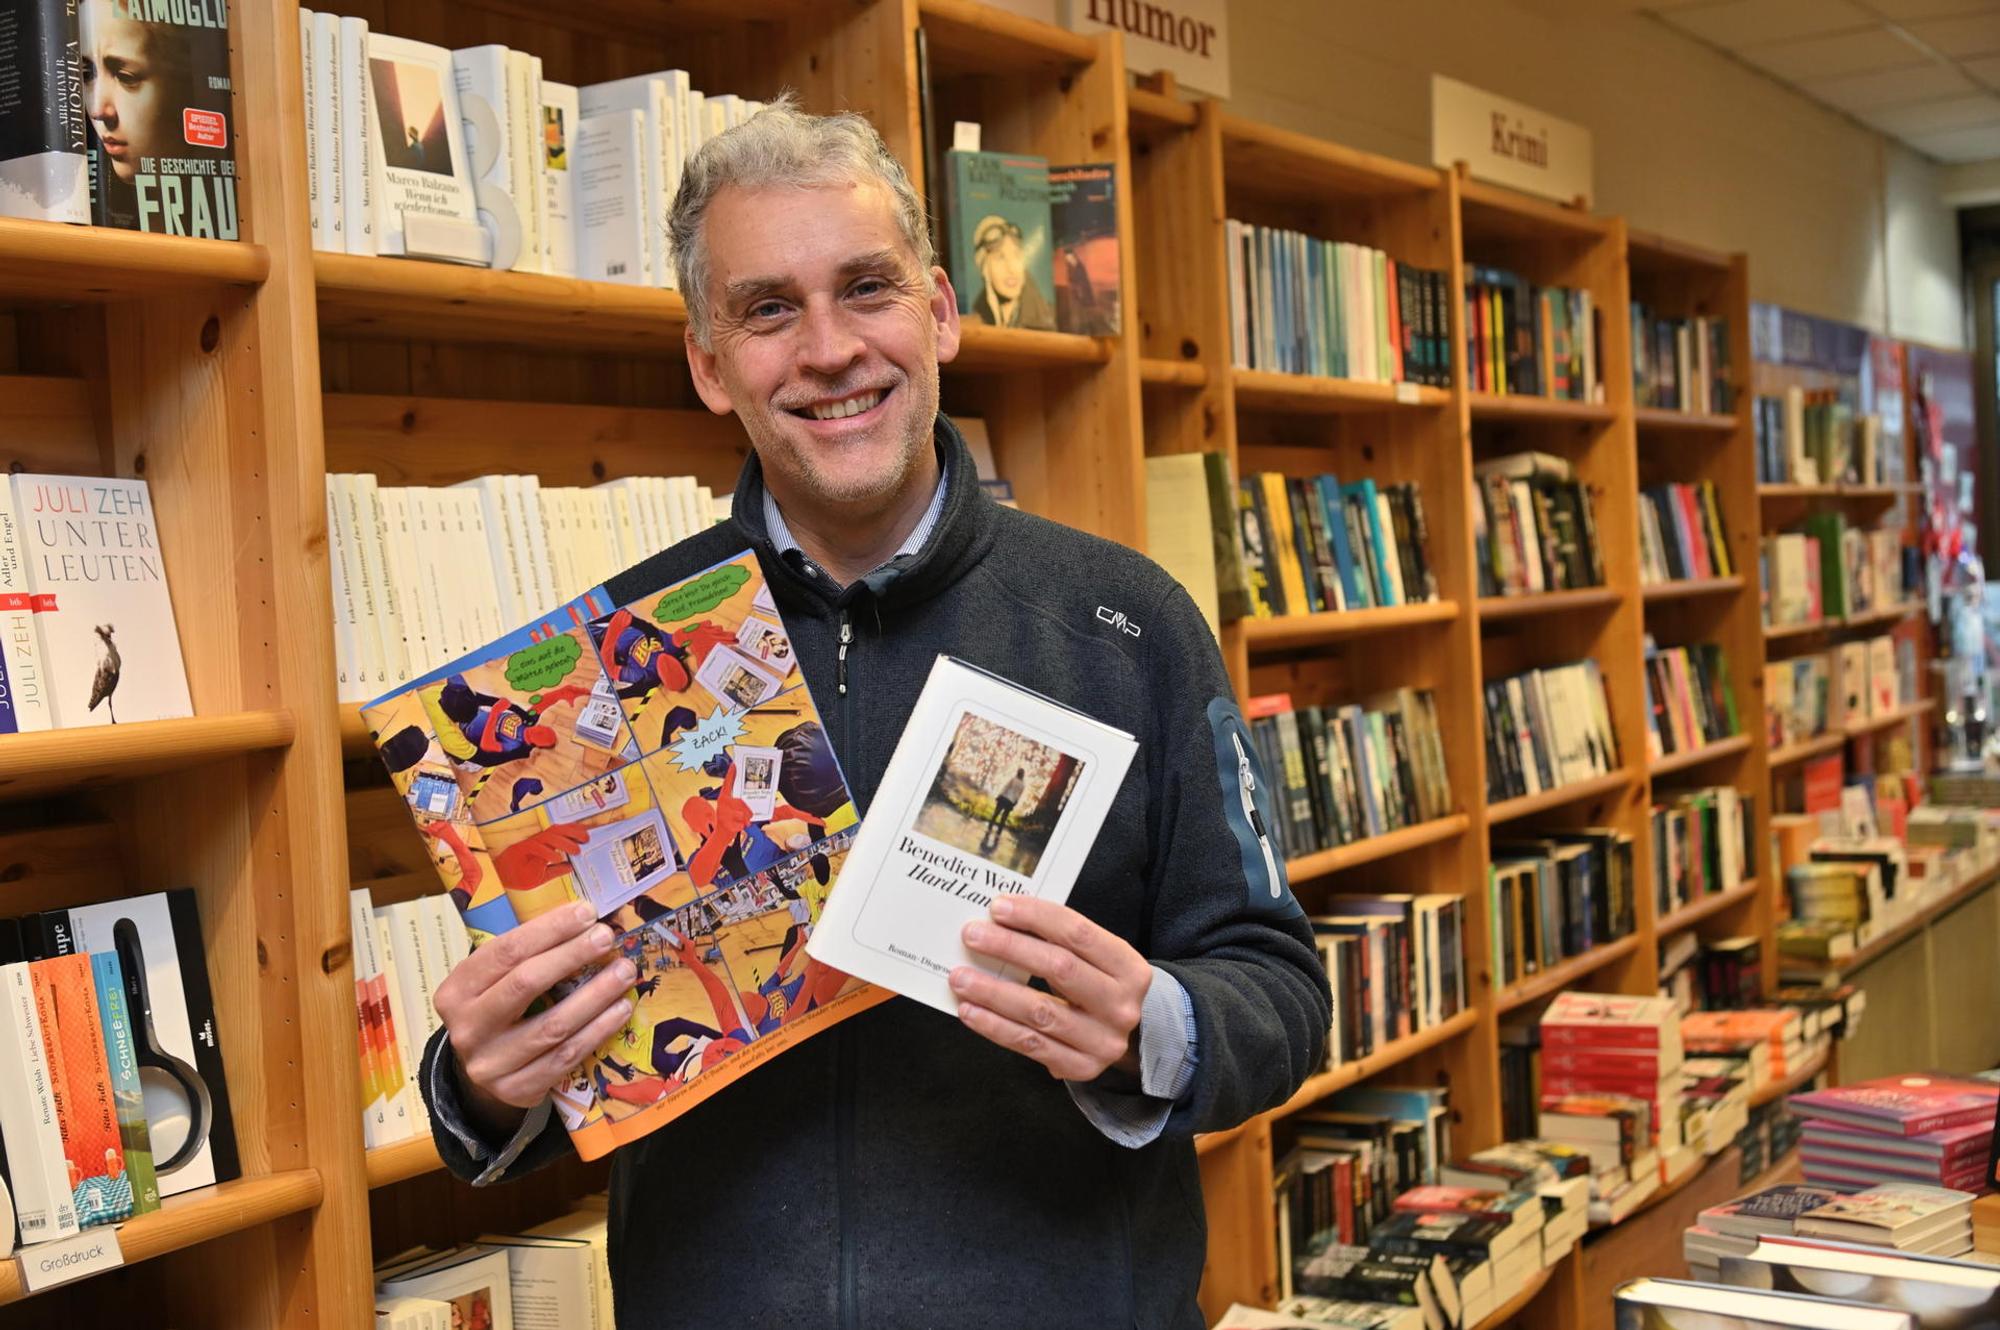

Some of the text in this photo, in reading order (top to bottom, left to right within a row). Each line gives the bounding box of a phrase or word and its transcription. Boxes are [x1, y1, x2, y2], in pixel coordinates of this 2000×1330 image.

[57, 67, 69, 127] ABRAHAM
[66, 41, 85, 149] YEHOSHUA
[1490, 111, 1549, 169] Krimi
[141, 157, 156, 174] DIE
[161, 158, 217, 176] GESCHICHTE
[386, 172, 460, 193] Marco Balzano
[405, 188, 432, 202] Wenn
[134, 175, 239, 241] FRAU
[33, 484, 146, 515] JULI ZEH
[1, 513, 14, 544] Engel
[37, 519, 154, 549] UNTER
[3, 555, 13, 587] Adler
[43, 554, 160, 582] LEUTEN
[11, 616, 41, 708] JULI ZEH
[691, 726, 728, 749] ZACK!
[899, 836, 978, 881] Benedict
[907, 863, 992, 908] Hard Lan
[54, 923, 71, 956] upe
[887, 943, 917, 961] Roman
[39, 1092, 51, 1126] Renate
[40, 1244, 104, 1272] Großdruck
